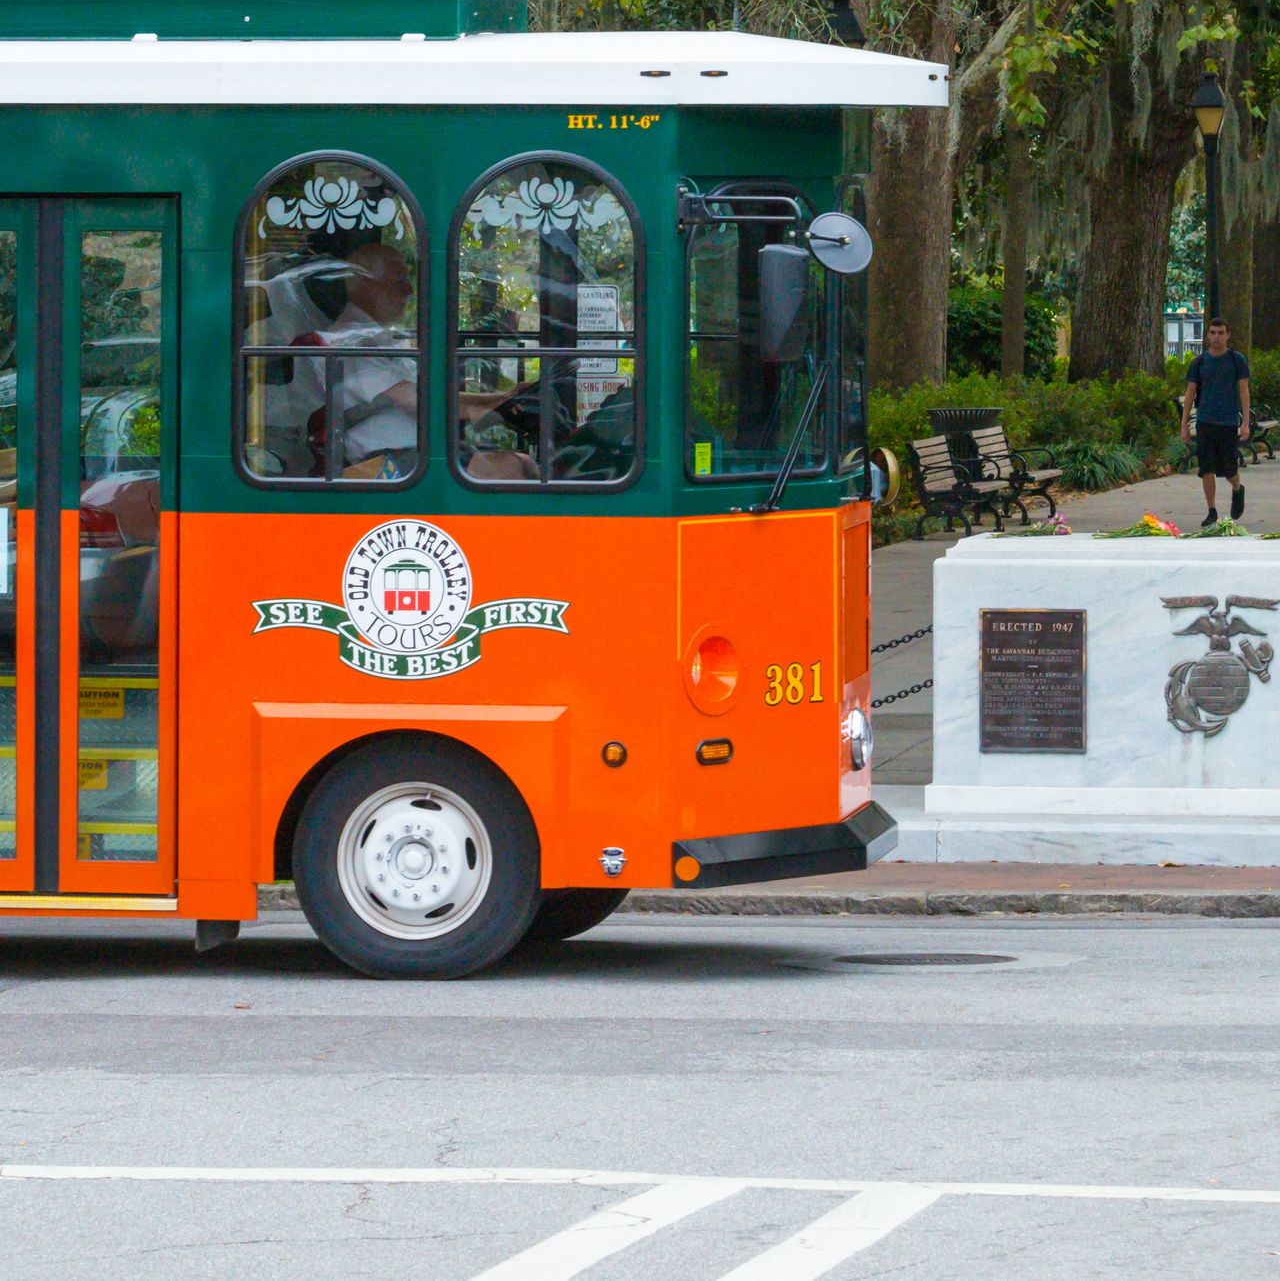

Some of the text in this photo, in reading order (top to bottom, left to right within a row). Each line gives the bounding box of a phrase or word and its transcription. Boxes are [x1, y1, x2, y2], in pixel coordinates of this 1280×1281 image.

[568, 115, 603, 129] HT.
[348, 525, 468, 601] OLD TOWN TROLLEY
[270, 602, 559, 676] SEE THE BEST FIRST
[362, 612, 454, 651] TOURS
[992, 623, 1074, 633] ERECTED 1947
[764, 660, 824, 706] 381
